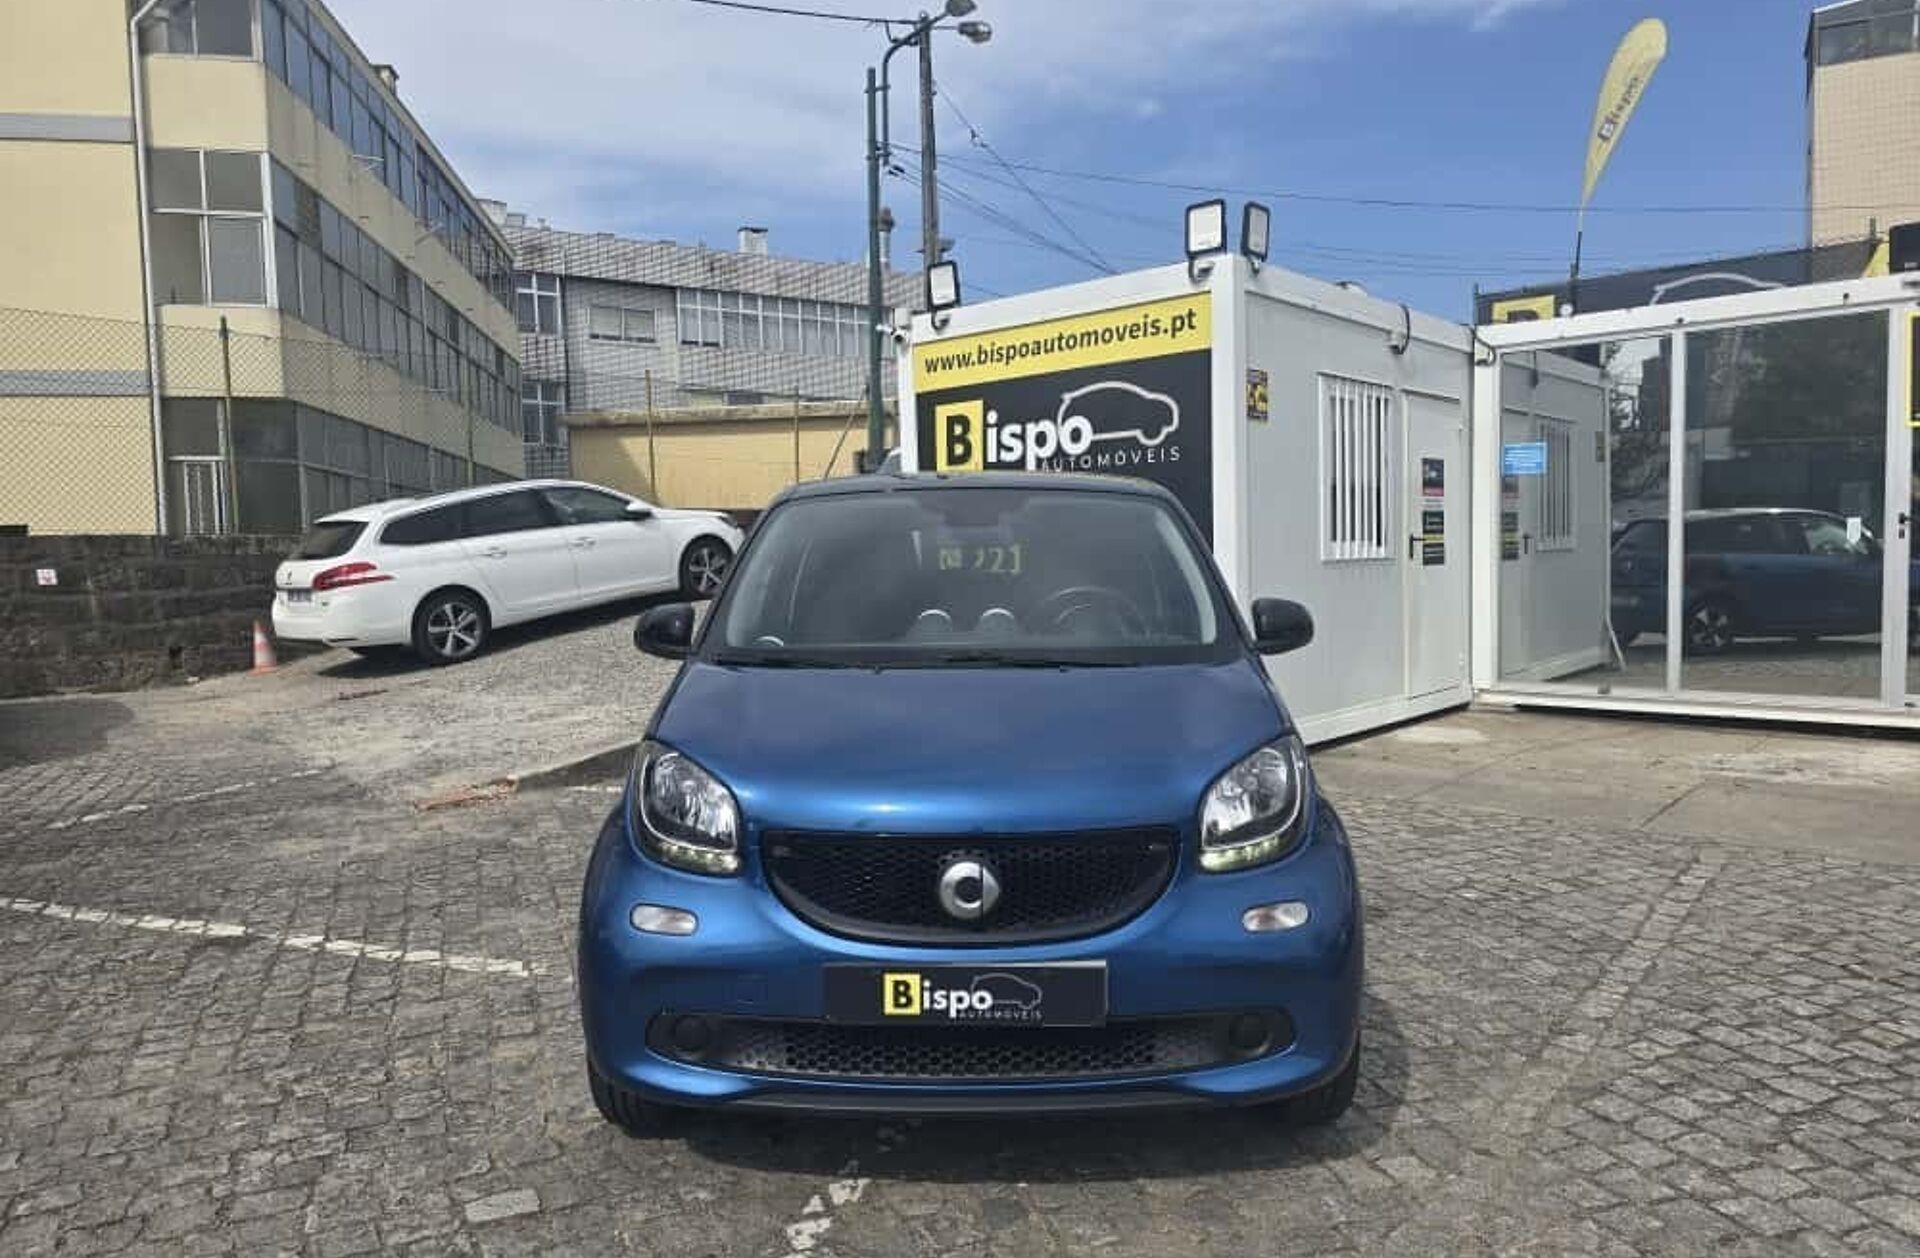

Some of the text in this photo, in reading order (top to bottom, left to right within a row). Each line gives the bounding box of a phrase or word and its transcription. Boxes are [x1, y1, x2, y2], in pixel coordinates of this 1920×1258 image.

[924, 307, 1197, 374] www.bispoautomoveis.pt
[944, 409, 1094, 472] Bispo
[891, 978, 993, 1019] Bispo
